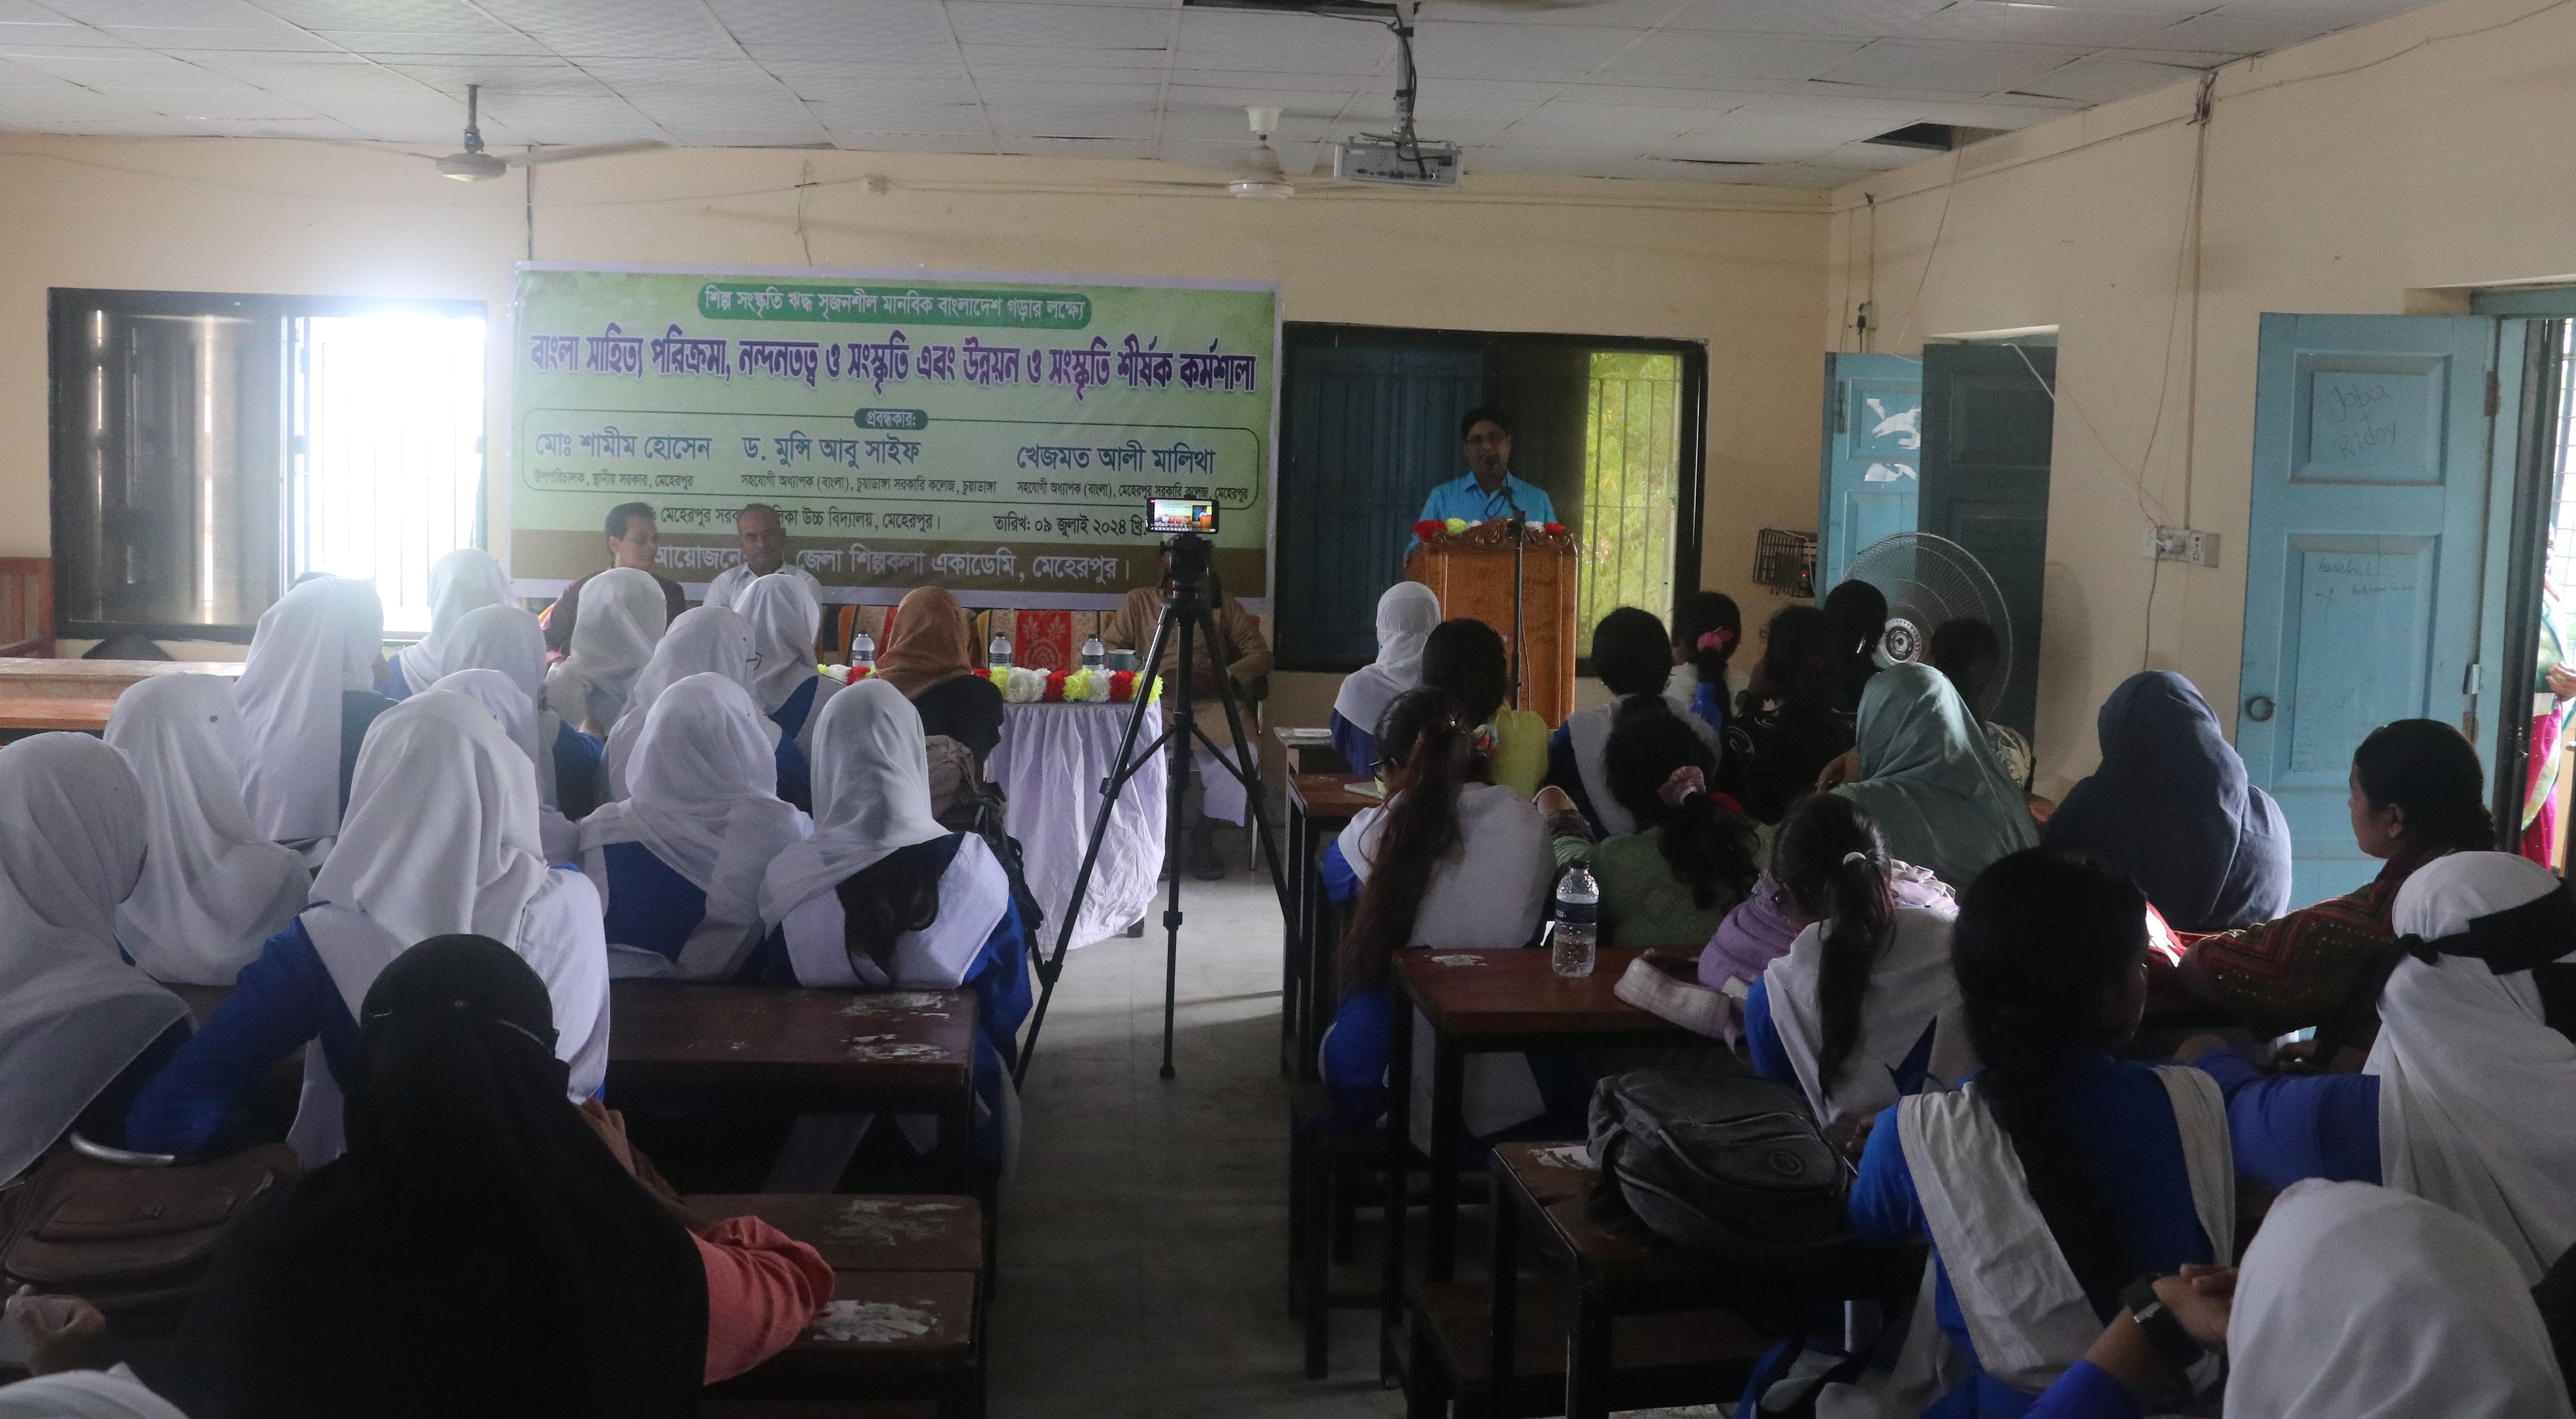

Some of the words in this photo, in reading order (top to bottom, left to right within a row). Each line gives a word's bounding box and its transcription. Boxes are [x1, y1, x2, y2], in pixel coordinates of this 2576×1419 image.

[705, 284, 732, 311] শিল্প
[735, 286, 783, 318] সংস্কৃতি
[789, 291, 814, 312] ঋদ্ধ
[818, 287, 878, 320] সৃজনশীল
[882, 289, 933, 316] মানবিক
[937, 296, 1002, 317] বাংলাদেশ
[1007, 298, 1043, 321] গড়ার
[1046, 300, 1085, 320] লক্ষ্যে
[530, 335, 579, 371] বাংলা
[586, 322, 643, 379] সাহিত্য
[650, 323, 730, 382] পরিক্রমা,
[826, 343, 840, 378] ও
[848, 329, 909, 396] সংস্কৃতি
[917, 345, 955, 381] এবং
[963, 336, 1020, 385] উন্নয়ন
[1027, 349, 1042, 383] ও
[1049, 336, 1111, 401] সংস্কৃতি
[1117, 333, 1173, 387] শীর্ষক
[1180, 338, 1256, 390] কর্মশালা
[536, 433, 571, 457] মোঃ
[579, 426, 638, 458] শামীম
[645, 434, 713, 461] হোসেন
[742, 437, 766, 461] ড.
[774, 430, 813, 466] মুন্সি
[819, 438, 859, 469] আবু
[865, 432, 921, 464] সাইফ
[1017, 444, 1092, 470] খেজমত
[1097, 439, 1146, 472] আলী
[1152, 442, 1216, 474] মালিথা
[655, 475, 694, 490] মেহেরপুর
[741, 471, 775, 487] সহযোগী
[779, 475, 814, 487] অধ্যাপক
[857, 477, 890, 493] চুয়াডাঙ্গা
[894, 475, 925, 490] সরকারি
[962, 481, 997, 495] চুয়াডাঙ্গা
[1017, 478, 1047, 494] সহযোগী
[1051, 482, 1081, 495] অধ্যাপক
[1155, 482, 1182, 498] সরকারি
[1215, 487, 1248, 503] মেহেরপুর
[661, 507, 711, 527] মেহেরপুর
[802, 506, 825, 525] উচ্চ
[1035, 519, 1051, 533] ০৯
[1057, 515, 1089, 537] জুলাই
[1094, 519, 1126, 536] ২০২৪
[796, 549, 843, 572] জেলা
[849, 543, 926, 576] শিল্পকলা
[933, 547, 1025, 582] একাডেমি,
